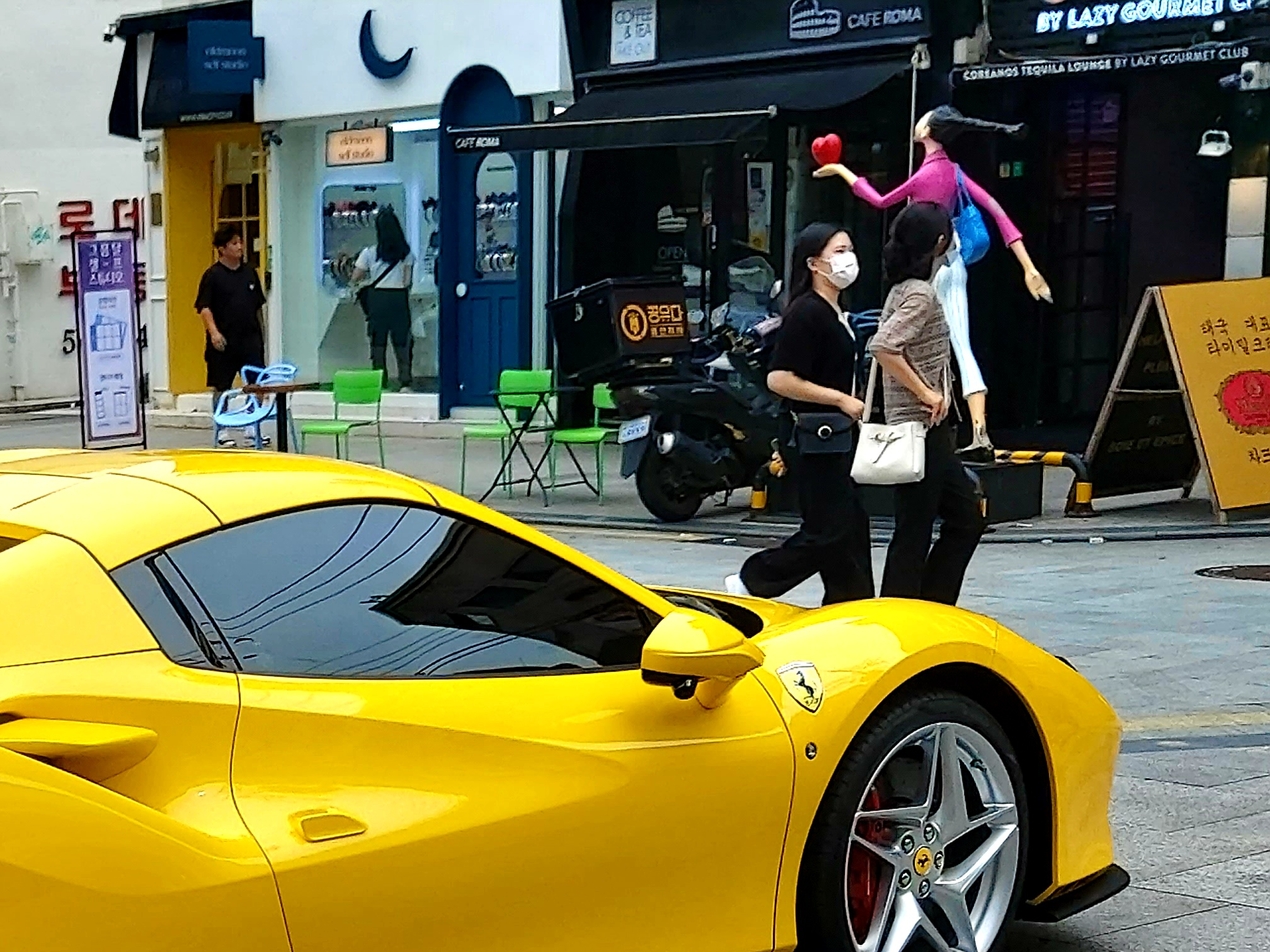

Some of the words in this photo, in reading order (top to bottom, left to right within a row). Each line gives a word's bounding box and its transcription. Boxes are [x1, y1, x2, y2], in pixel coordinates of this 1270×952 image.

[847, 11, 882, 29] CAFE
[883, 6, 923, 25] ROMA
[1035, 11, 1061, 33] BY
[1067, 3, 1118, 30] LAZY
[1021, 62, 1065, 77] TEQUILA
[1067, 59, 1111, 73] LOUNGE
[1114, 58, 1128, 70] BY
[1130, 55, 1158, 68] LAZY
[1159, 50, 1216, 64] GOURMET
[1218, 46, 1249, 59] CLUB
